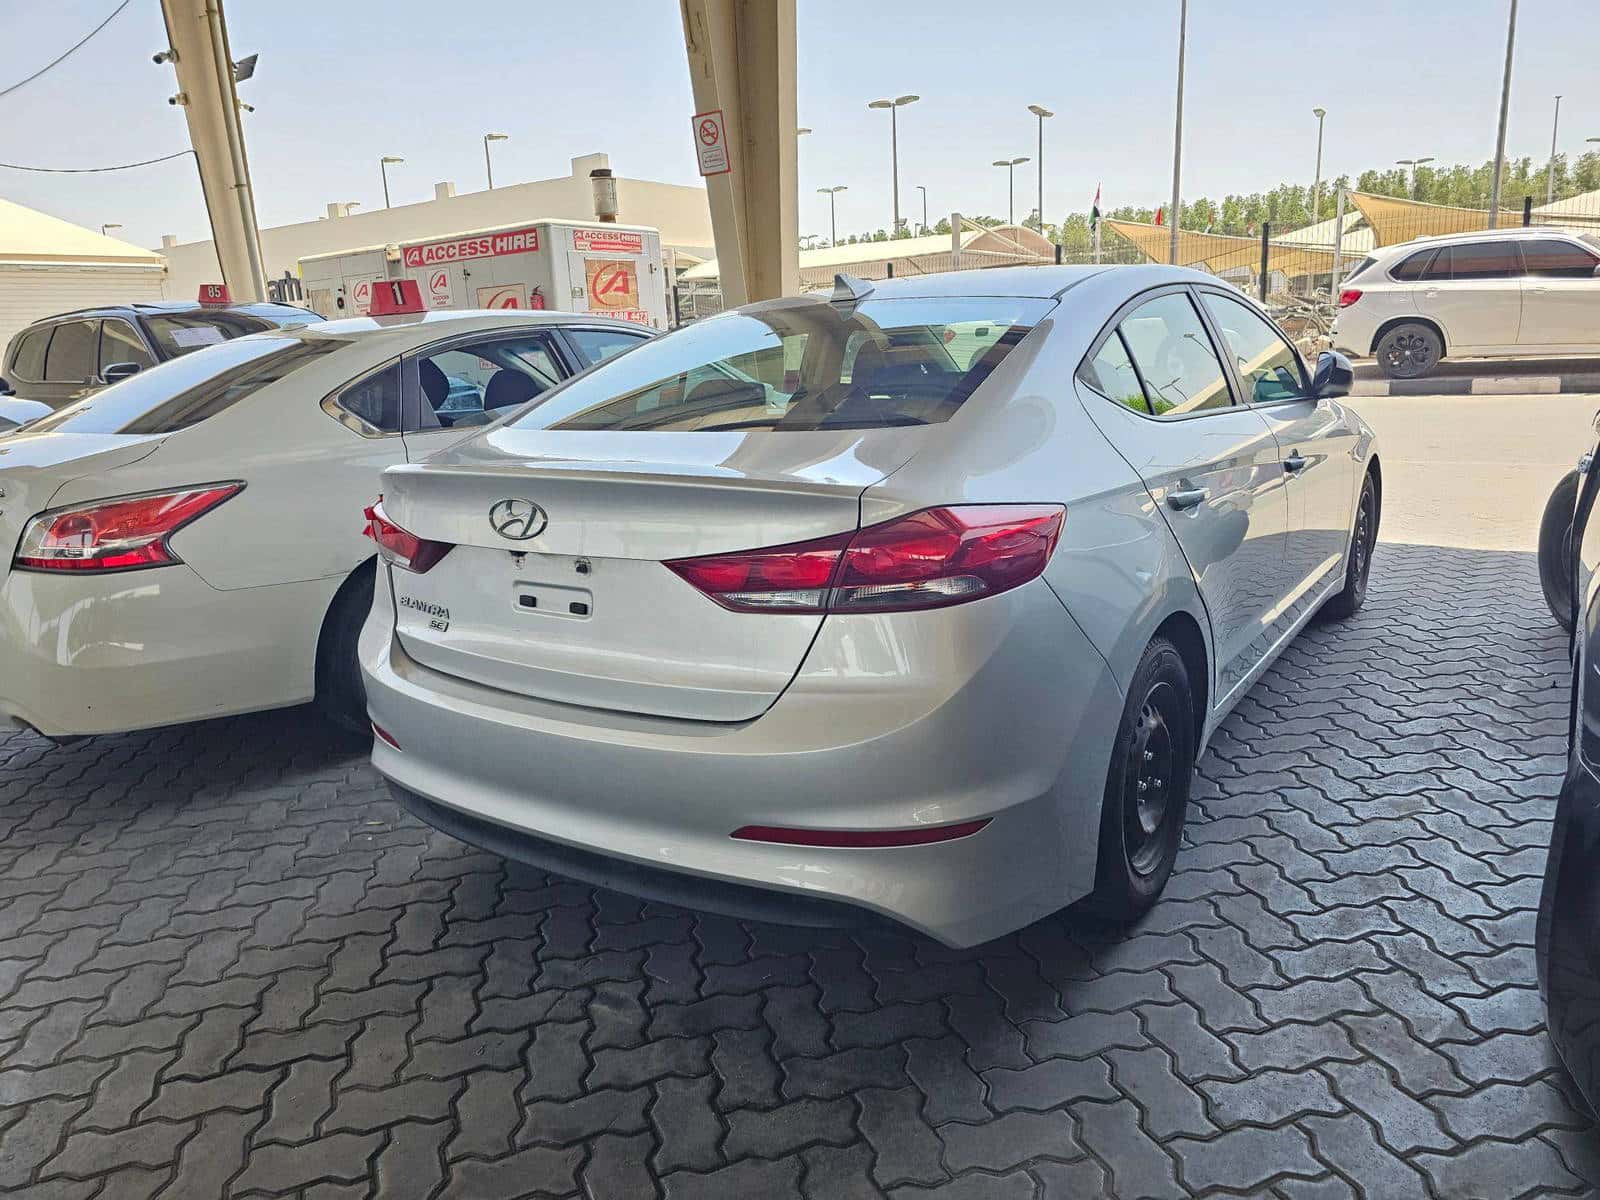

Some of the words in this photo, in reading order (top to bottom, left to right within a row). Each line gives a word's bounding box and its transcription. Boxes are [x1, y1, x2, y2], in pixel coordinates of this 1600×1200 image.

[584, 231, 620, 241] ACCESS
[425, 239, 491, 262] ACCESS
[495, 232, 537, 253] HIRE
[207, 285, 222, 298] 85
[391, 281, 404, 305] 1
[400, 596, 450, 620] ELANTRA
[431, 620, 444, 630] SE
